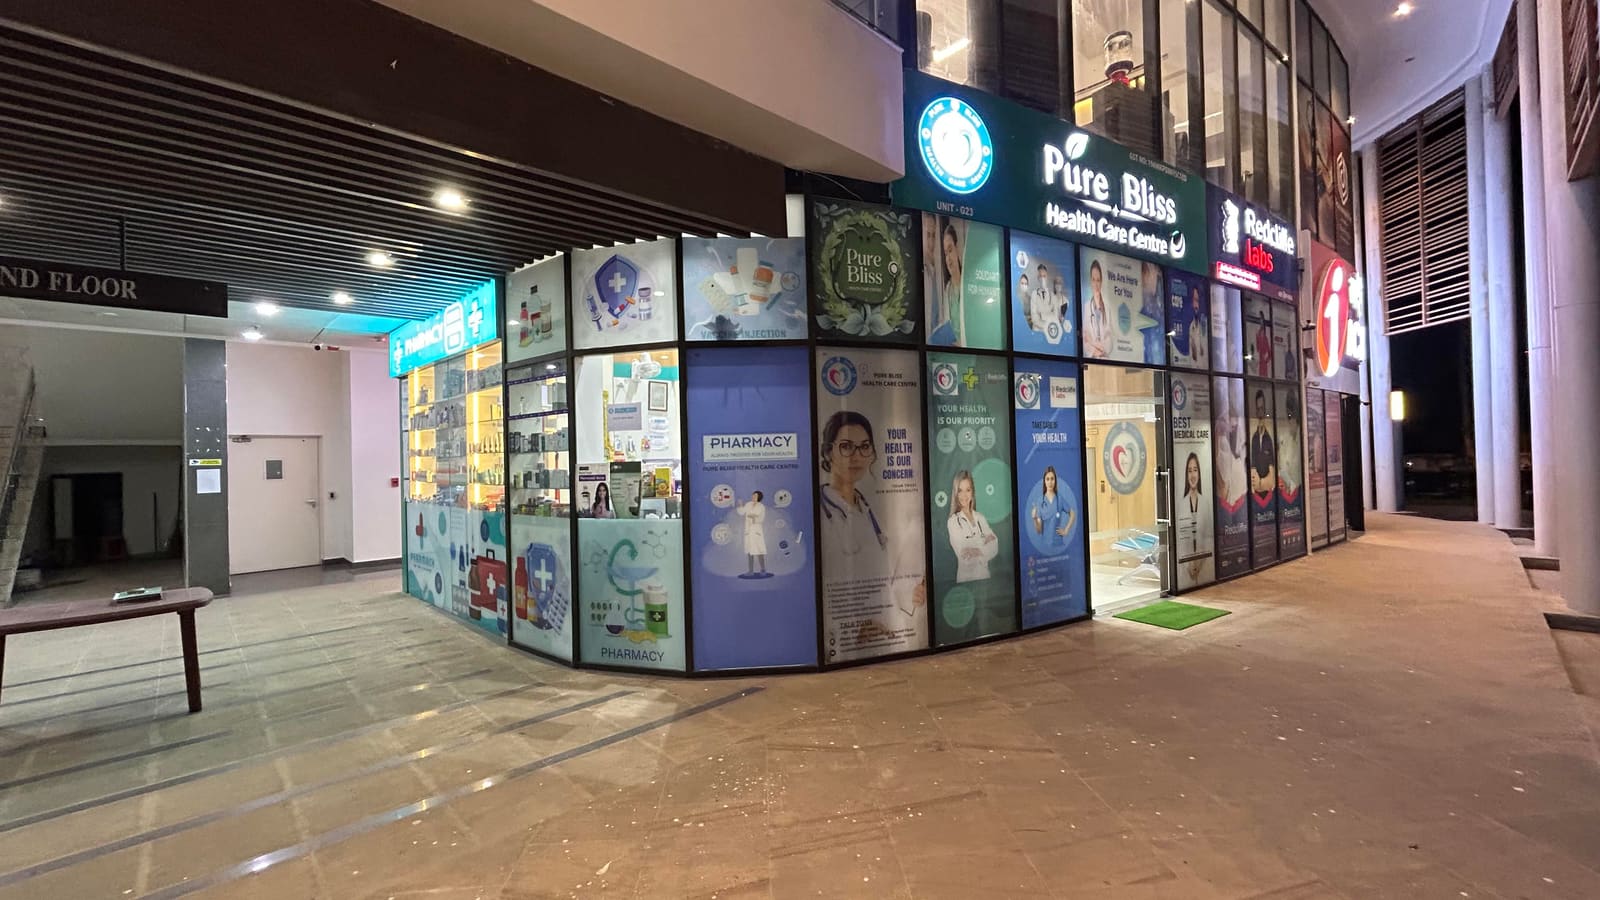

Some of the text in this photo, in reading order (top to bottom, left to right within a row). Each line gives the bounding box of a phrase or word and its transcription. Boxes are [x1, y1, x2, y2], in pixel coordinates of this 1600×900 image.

[1044, 144, 1109, 201] Pure
[1121, 172, 1176, 224] Bliss
[937, 201, 954, 212] UNIT
[960, 206, 974, 217] G23
[1046, 202, 1168, 254] Health Care Centre
[847, 248, 882, 267] Pure
[1245, 239, 1274, 272] labs
[847, 266, 883, 285] Bliss
[48, 271, 138, 300] FLOOR
[937, 405, 987, 413] YOUR HEALTH
[937, 417, 996, 425] IS OUR PRIORITY
[1173, 416, 1191, 429] BEST
[887, 428, 907, 440] YOUR
[1047, 433, 1067, 443] HEALTH
[710, 435, 792, 449] PHARMACY
[885, 442, 913, 454] HEALTH
[887, 456, 911, 466] IS OUR
[882, 469, 913, 480] CONCERN
[601, 647, 665, 662] PHARMACY
